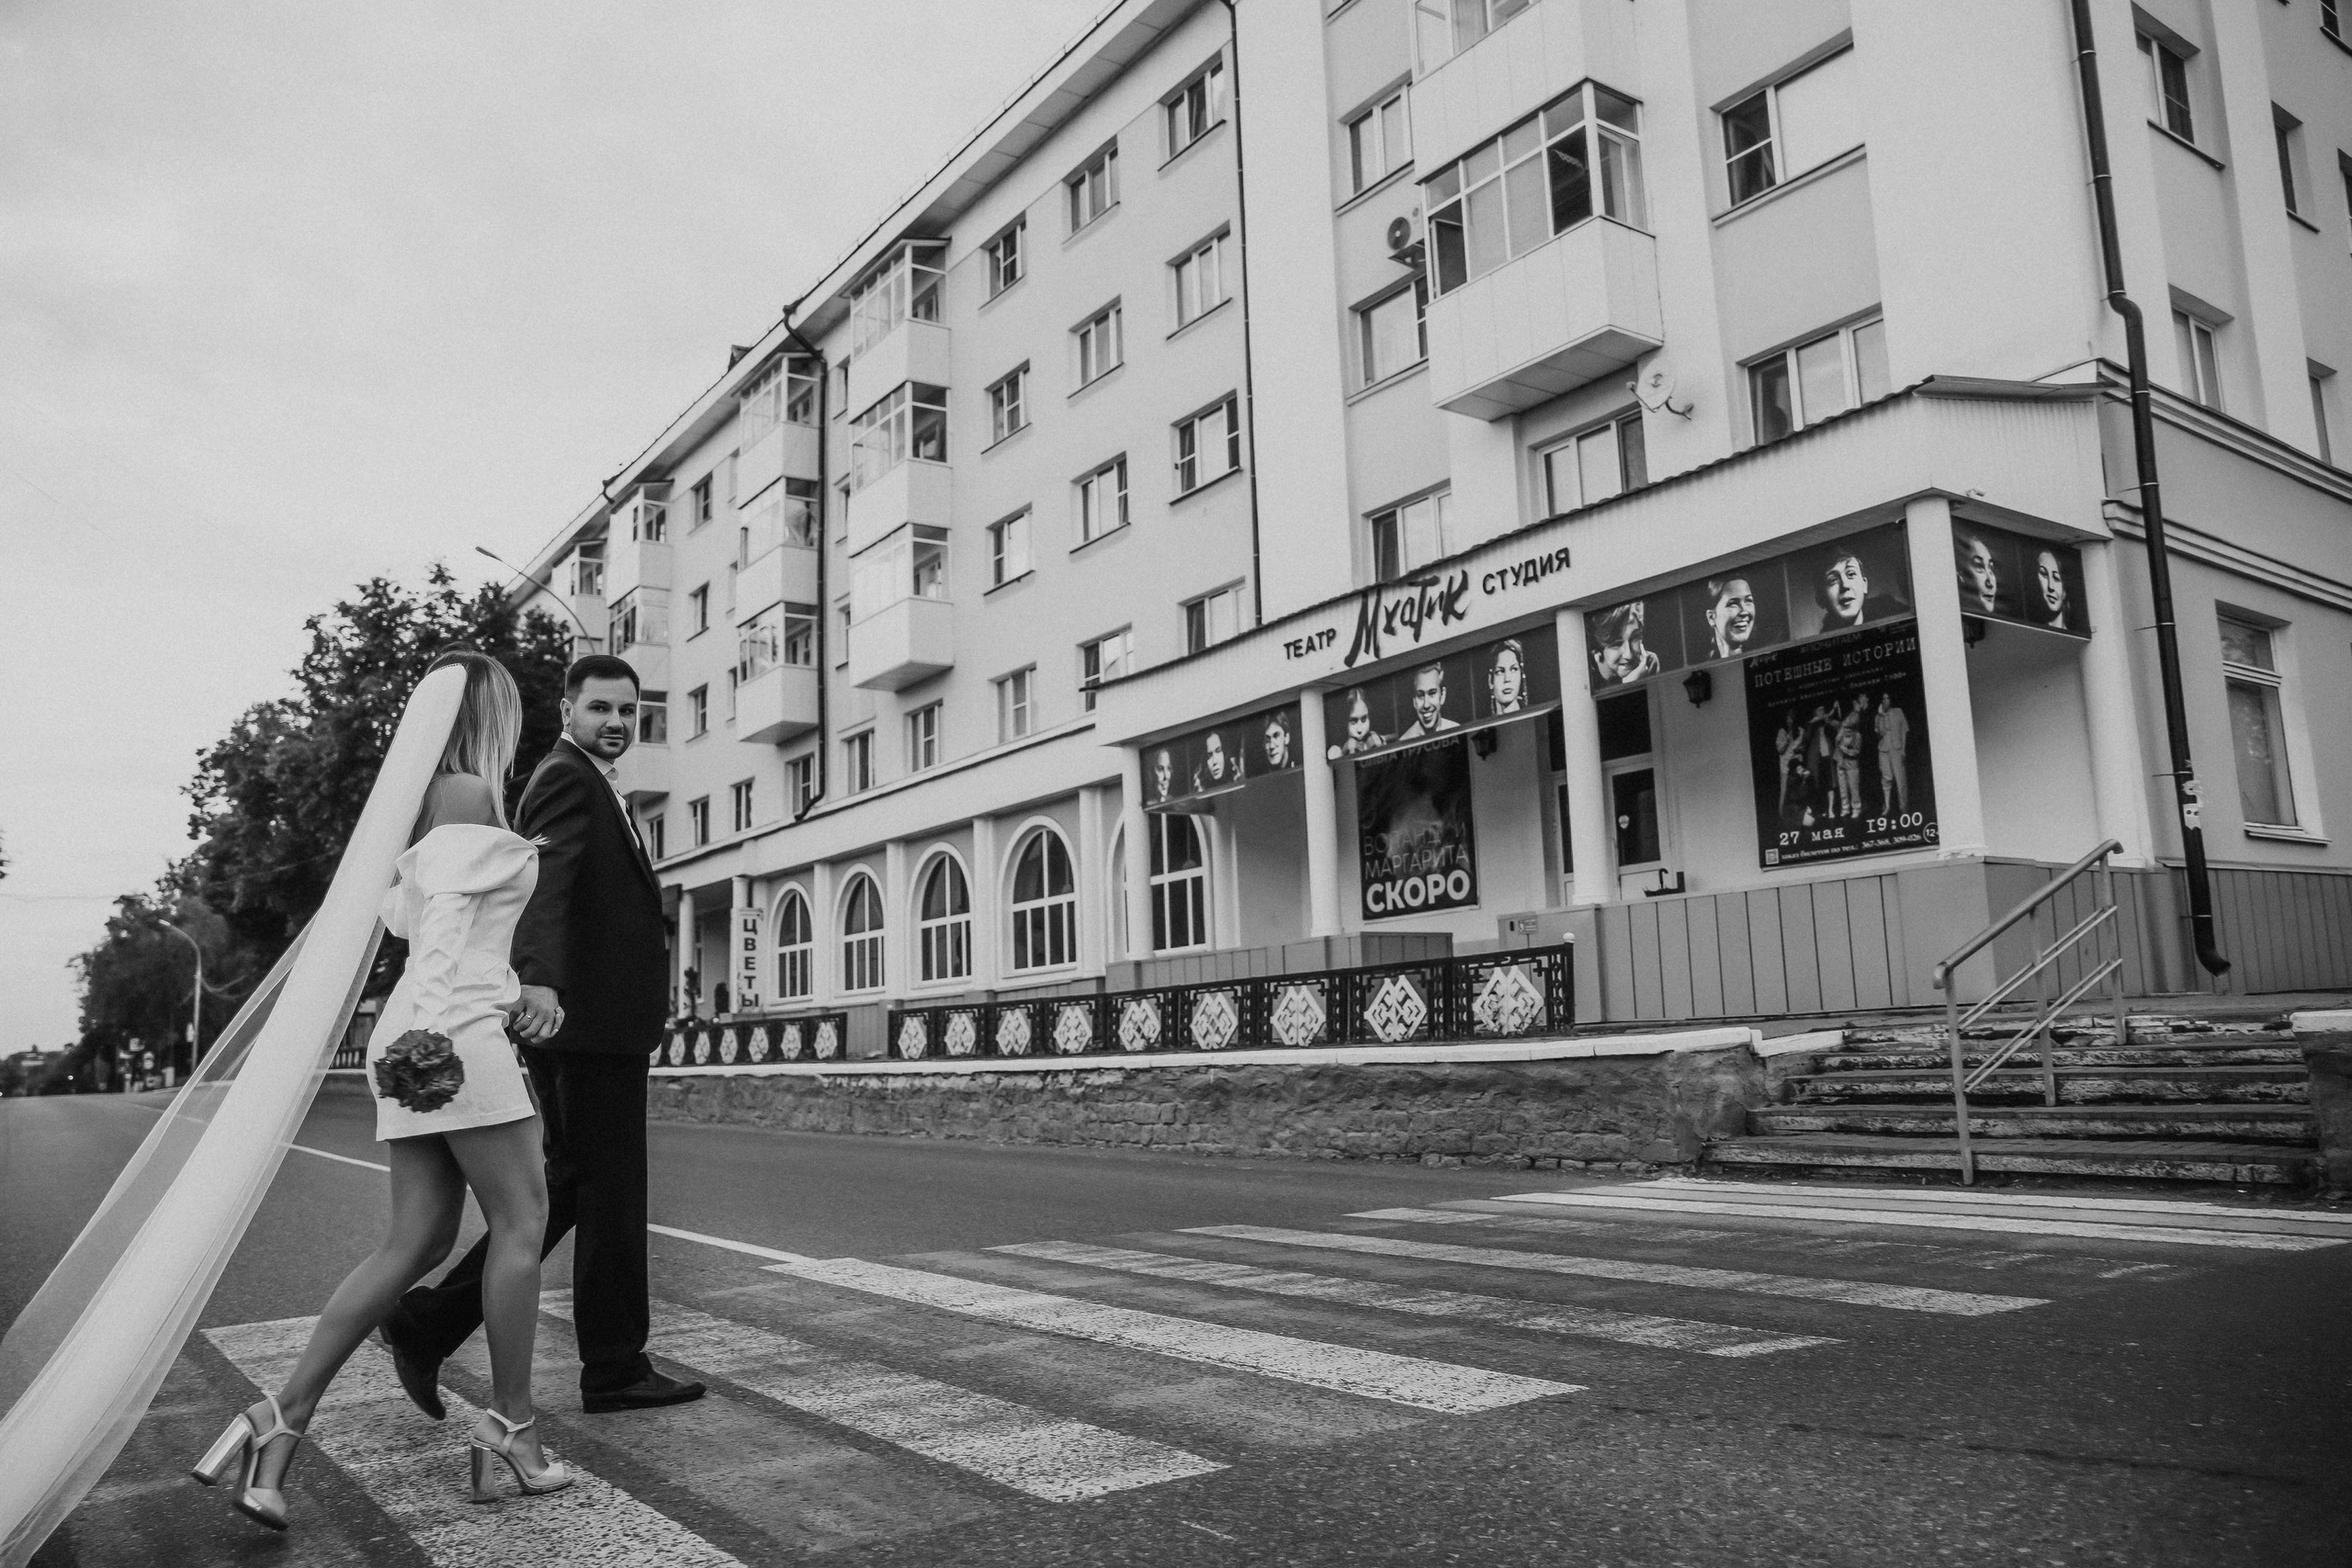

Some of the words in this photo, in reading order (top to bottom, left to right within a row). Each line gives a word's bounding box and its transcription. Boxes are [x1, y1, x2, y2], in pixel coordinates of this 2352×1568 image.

[1283, 627, 1337, 660] ТЕАТР
[1482, 547, 1571, 595] СТУДИЯ
[1754, 658, 1833, 687] ПОТЕШНЫЕ
[1842, 637, 1917, 667] ИСТОРИИ
[1779, 830, 1800, 846] 27
[1811, 828, 1845, 842] мая
[1866, 812, 1923, 833] 19:00
[1364, 844, 1470, 880] МАРГАРИТА
[1365, 869, 1470, 913] СКОРО
[741, 919, 760, 1009] ЦВЕТЫ
